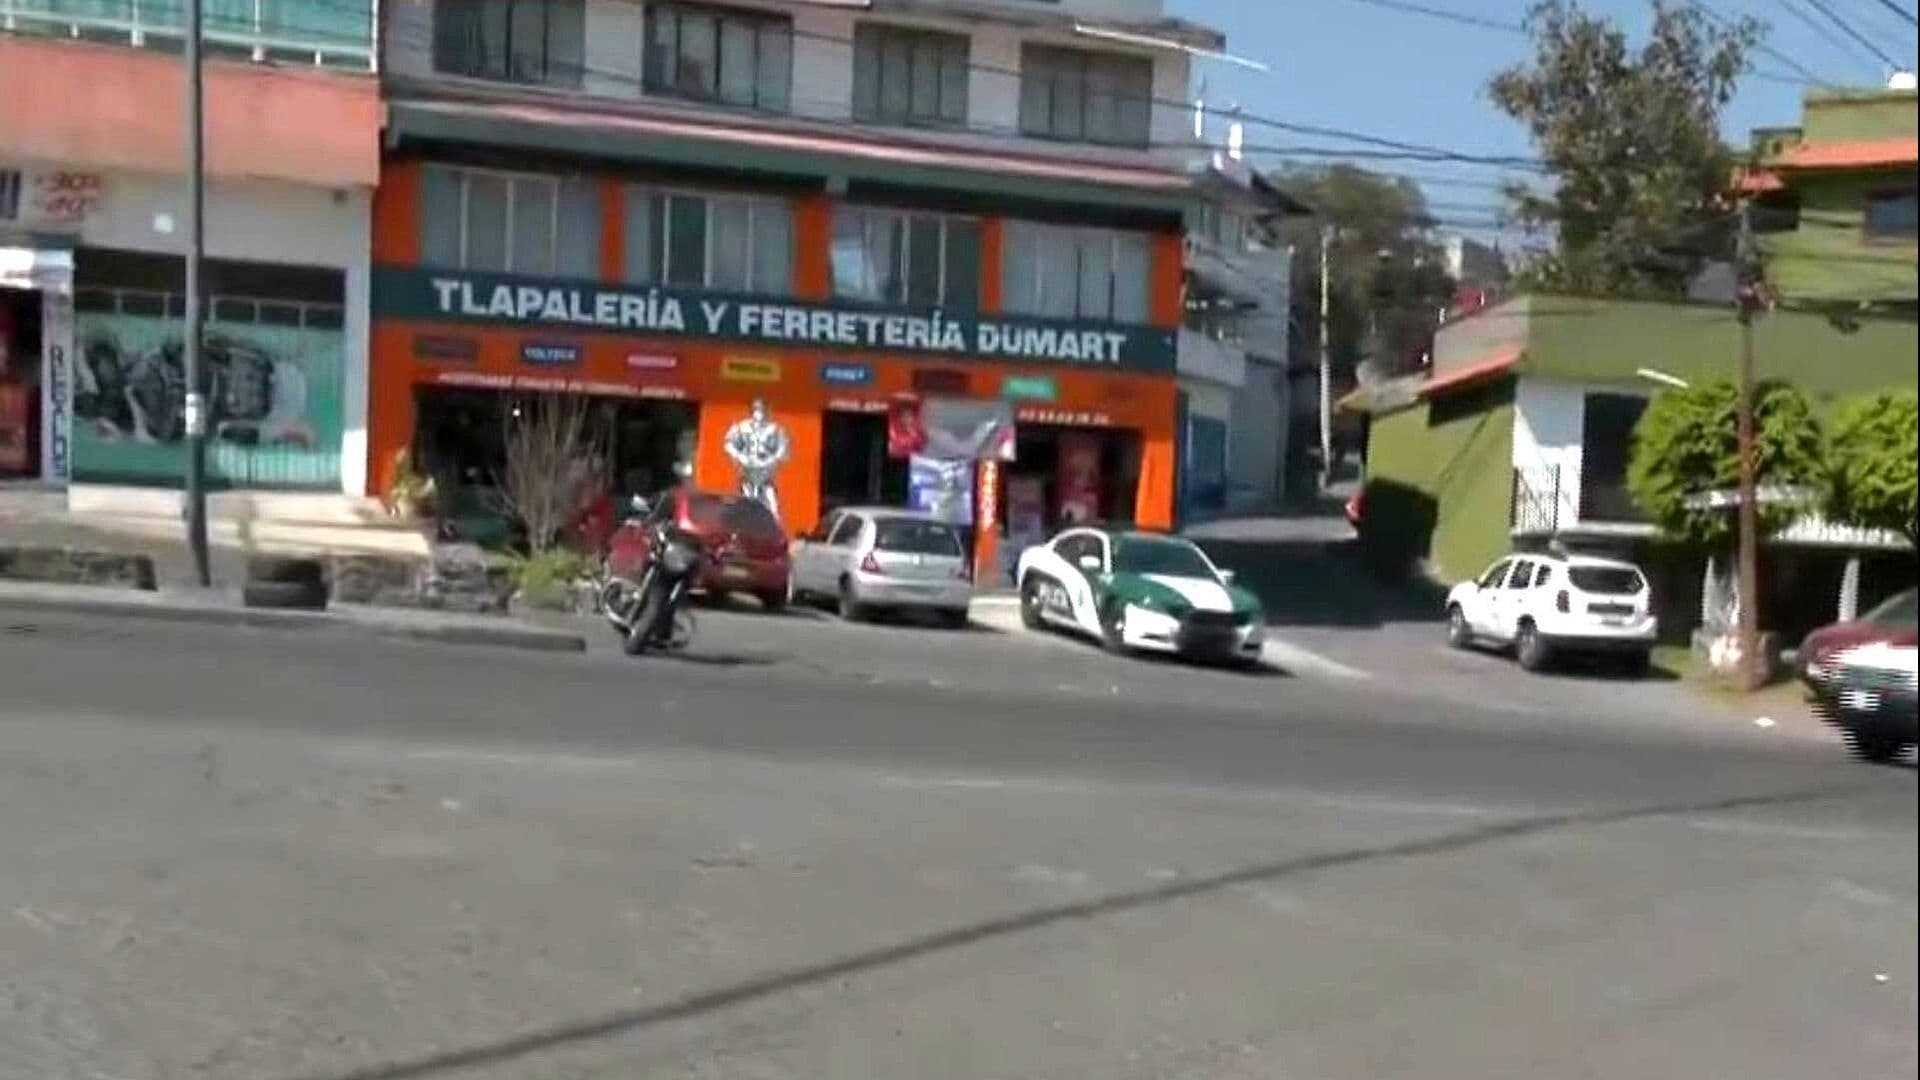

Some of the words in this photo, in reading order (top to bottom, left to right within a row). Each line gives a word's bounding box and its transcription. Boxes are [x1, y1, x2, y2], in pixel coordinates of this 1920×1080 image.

[433, 278, 684, 331] TLAPALERÍA
[703, 303, 728, 334] Y
[738, 306, 965, 351] FERRETERÍA
[977, 324, 1127, 362] DUMART
